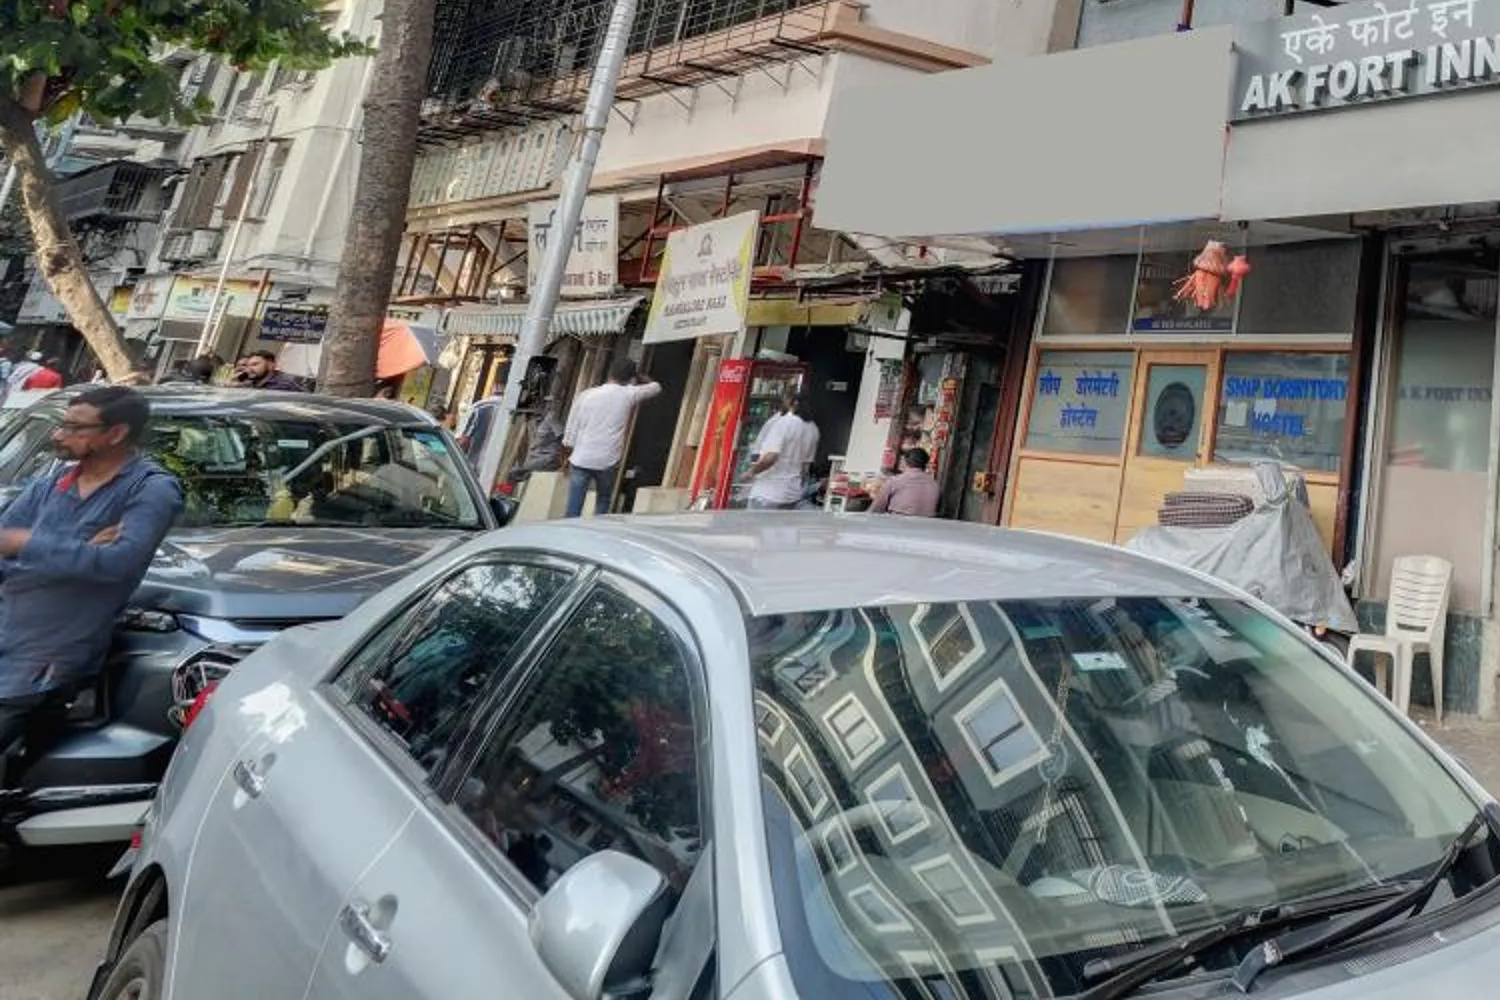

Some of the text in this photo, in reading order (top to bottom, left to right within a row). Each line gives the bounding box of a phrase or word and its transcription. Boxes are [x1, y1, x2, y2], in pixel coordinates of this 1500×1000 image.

[1281, 14, 1341, 64] एके
[1240, 69, 1300, 112] AK
[1305, 50, 1415, 104] FORT
[1226, 376, 1259, 398] SHIP
